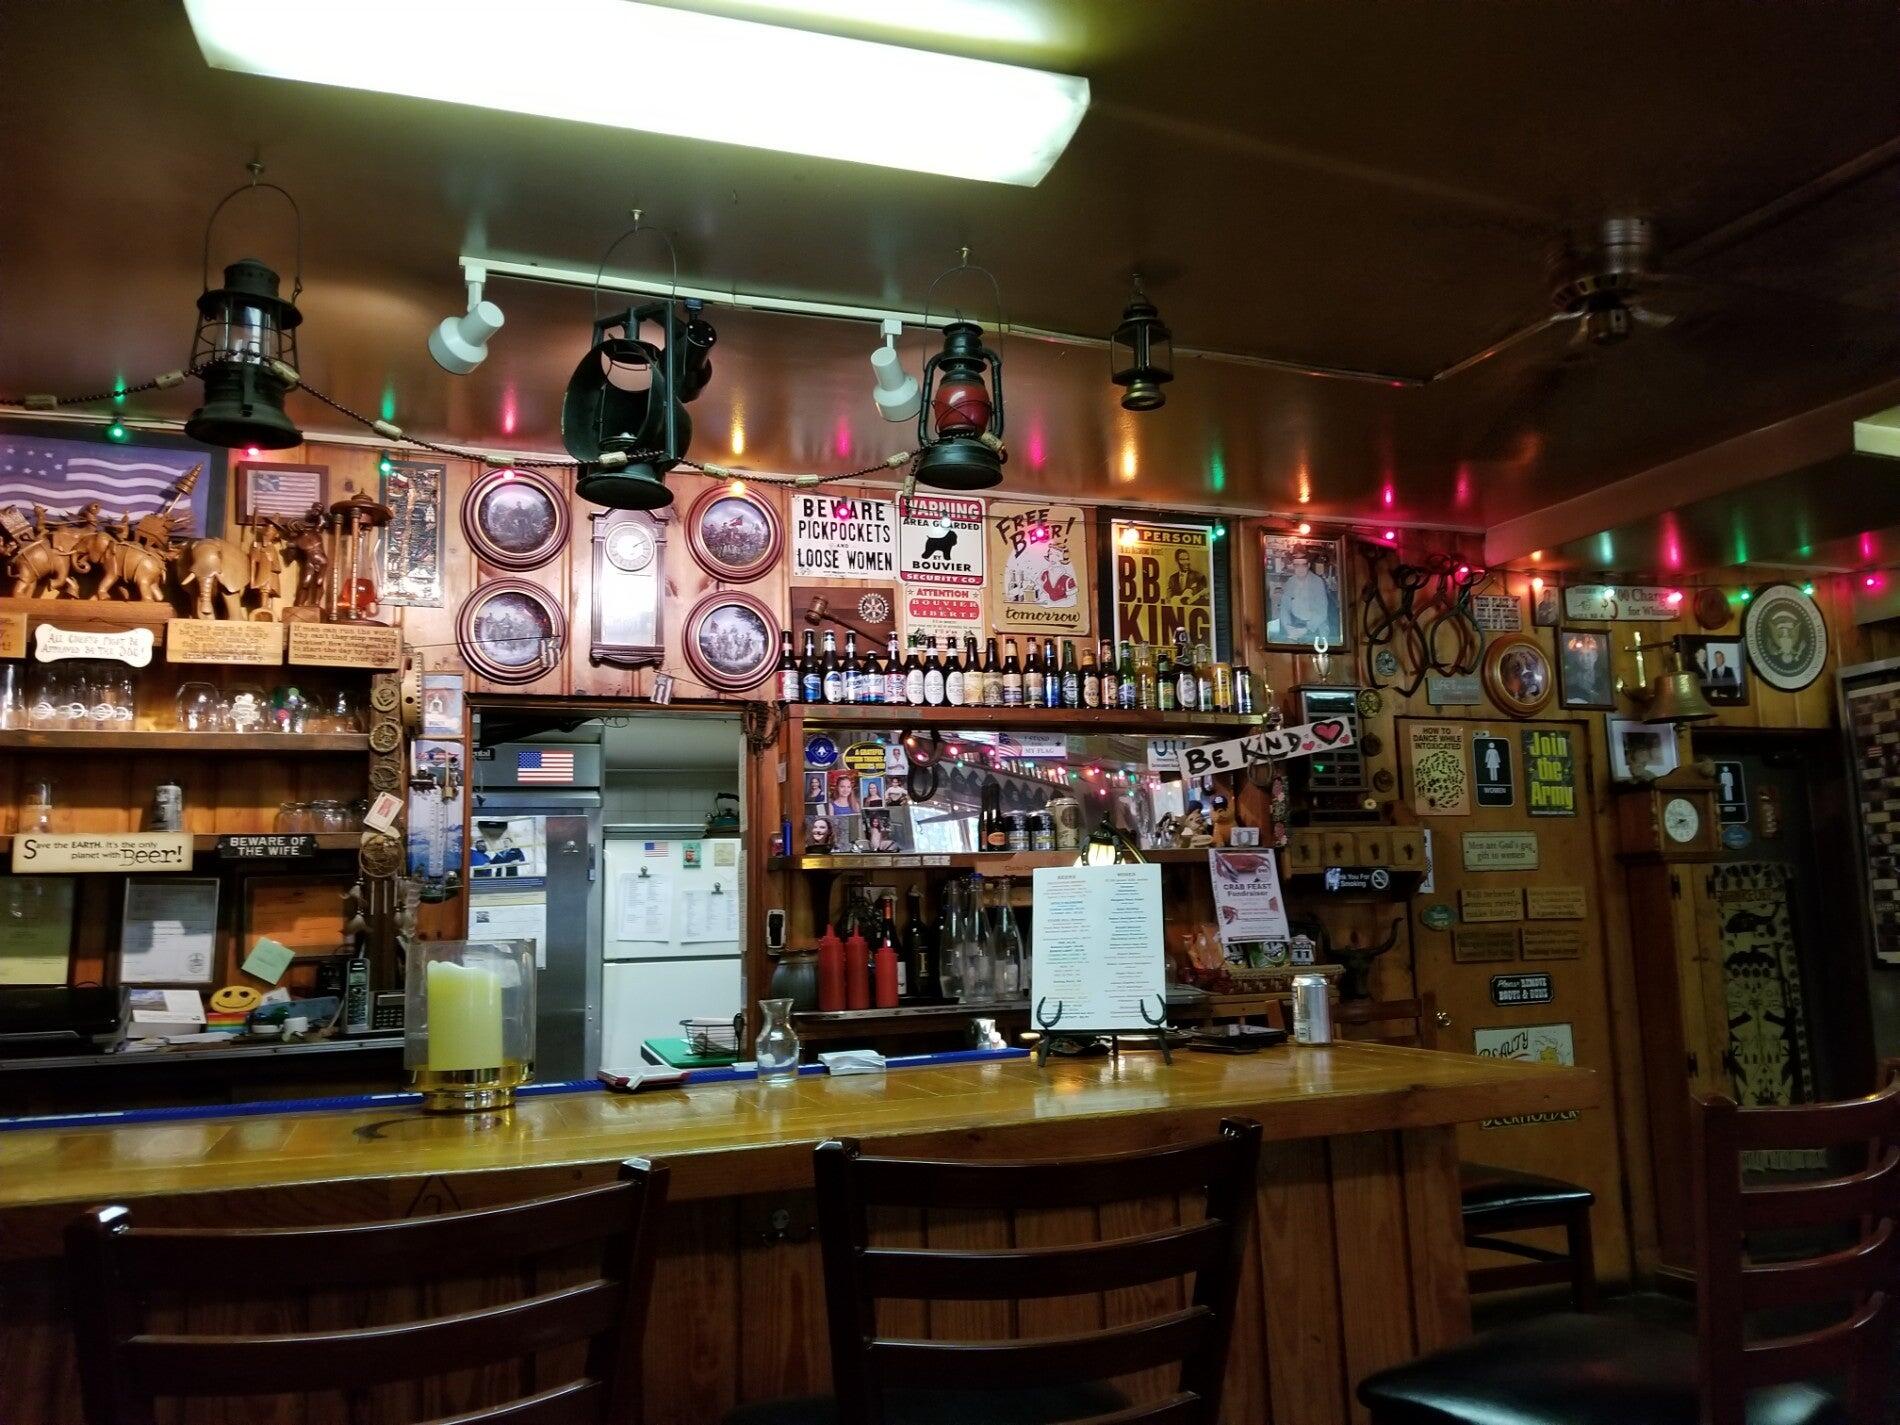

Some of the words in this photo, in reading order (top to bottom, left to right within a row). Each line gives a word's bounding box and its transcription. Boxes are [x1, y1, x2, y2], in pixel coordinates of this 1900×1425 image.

[803, 498, 885, 521] BEWARE
[904, 498, 980, 520] WARNING
[798, 520, 890, 543] PICKPOCKETS
[903, 517, 929, 527] AREA
[932, 520, 980, 531] GARDED
[995, 509, 1050, 545] FREE
[1009, 516, 1077, 559] BEER!
[1143, 530, 1203, 545] PERSON
[797, 548, 840, 569] LOOSE
[846, 550, 893, 571] WOMEN
[912, 560, 972, 572] BOUVIER
[906, 573, 959, 583] SECURITY
[961, 575, 980, 584] CO.
[1117, 554, 1167, 605] B.B.
[916, 588, 969, 598] ATTENTION
[911, 599, 978, 608] BOUVIER
[1628, 606, 1641, 616] for
[912, 610, 978, 618] LIBERTE
[1005, 606, 1081, 623] tomorrow
[1119, 603, 1211, 648] KING
[1412, 734, 1438, 742] DANCE
[1439, 735, 1462, 743] WHILE
[1422, 727, 1440, 735] HOW
[1440, 727, 1452, 735] TO
[1415, 742, 1462, 750] INTOXICATED
[1530, 731, 1568, 757] Join
[1184, 748, 1230, 776] BE
[1239, 732, 1302, 764] KIND
[1536, 756, 1563, 782] the
[1531, 780, 1574, 811] Army
[23, 839, 52, 860] Save
[53, 841, 69, 849] the
[121, 841, 136, 849] the
[138, 841, 158, 850] only
[229, 836, 286, 847] BEWARE
[290, 836, 308, 846] OF
[71, 851, 101, 861] planet
[101, 851, 122, 860] with
[118, 845, 183, 867] Beer!
[237, 846, 264, 856] THE
[267, 846, 300, 856] WIFE
[1222, 883, 1246, 891] CRAB
[1247, 882, 1273, 891] FEAST
[1227, 889, 1269, 898] Fundraiser
